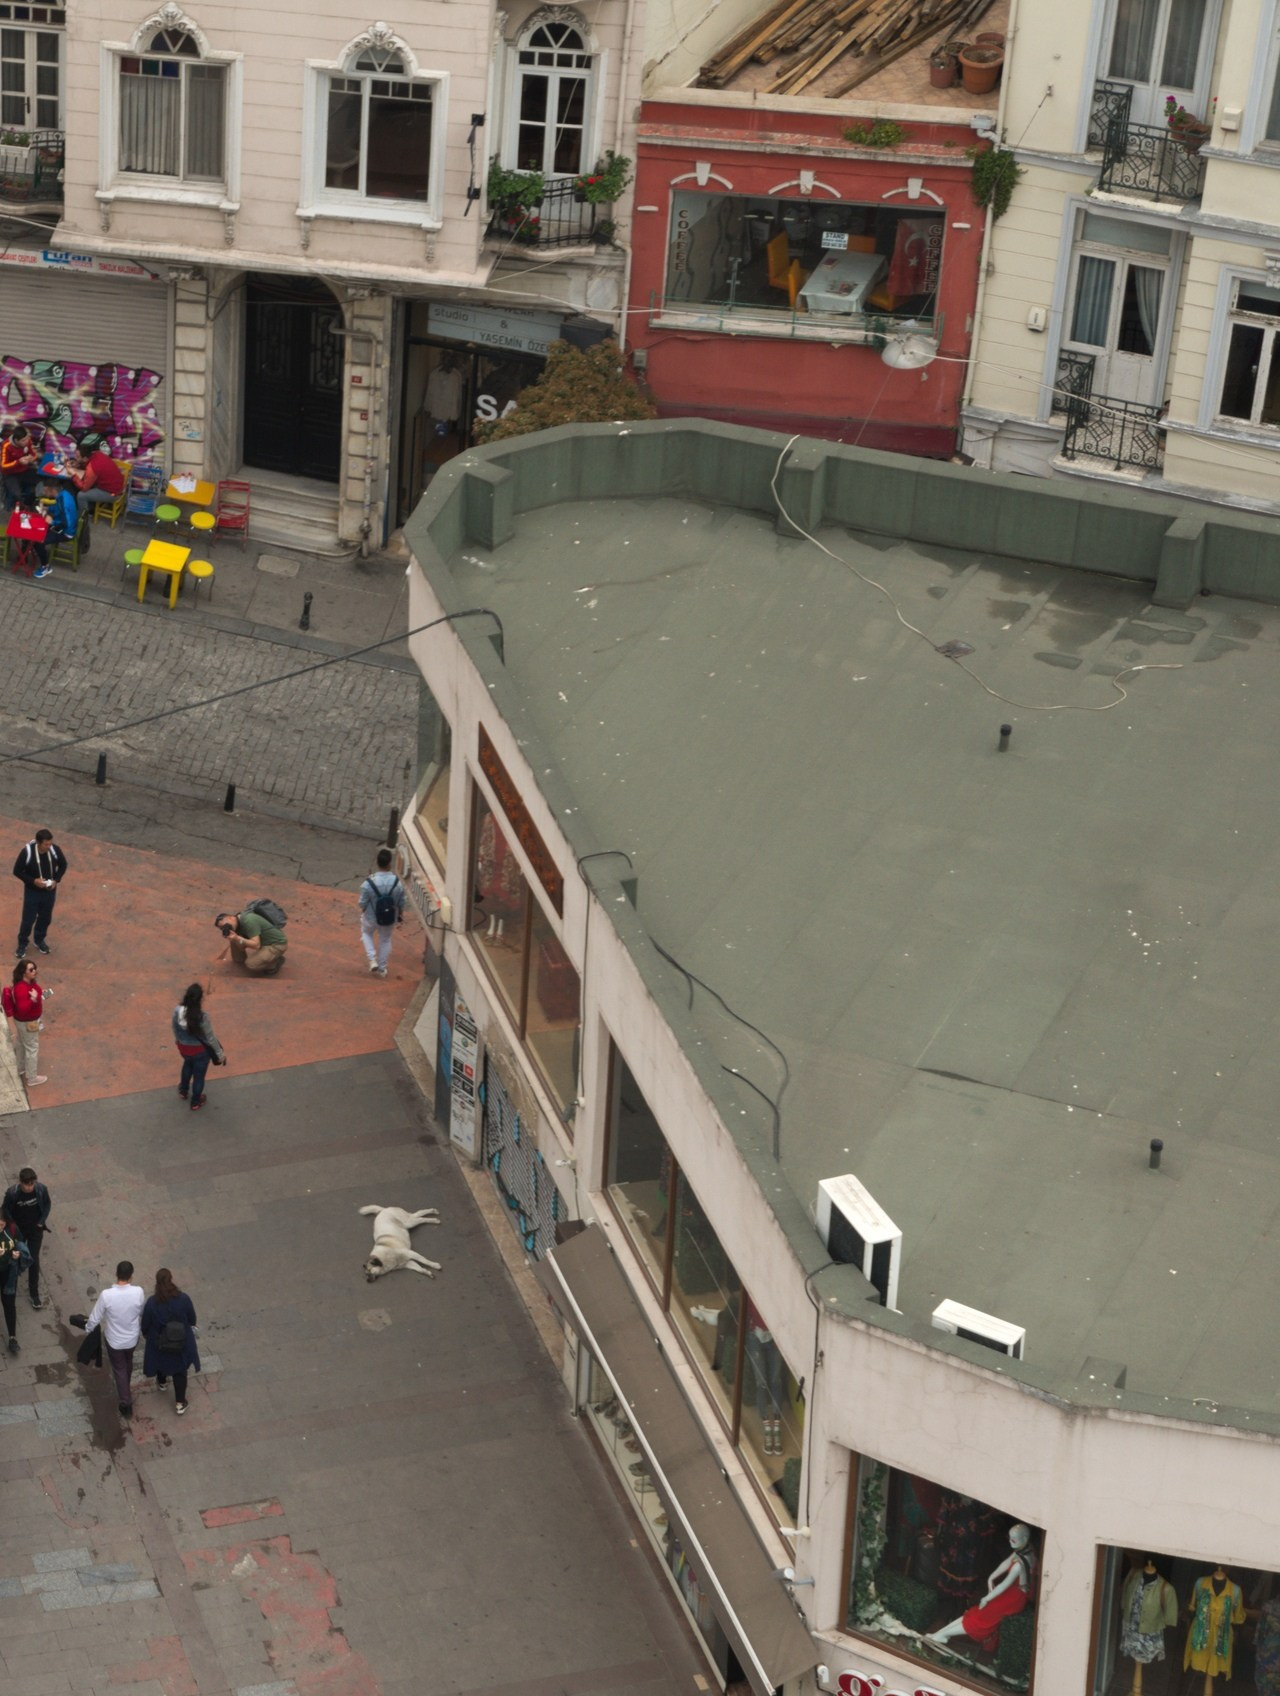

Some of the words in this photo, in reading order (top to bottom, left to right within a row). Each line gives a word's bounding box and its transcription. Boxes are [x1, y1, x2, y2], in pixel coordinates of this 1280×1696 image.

[675, 209, 689, 271] COFFEE
[923, 224, 942, 293] COFFEE
[434, 308, 469, 321] studio
[500, 319, 508, 329] &
[480, 332, 522, 348] YASEMİN
